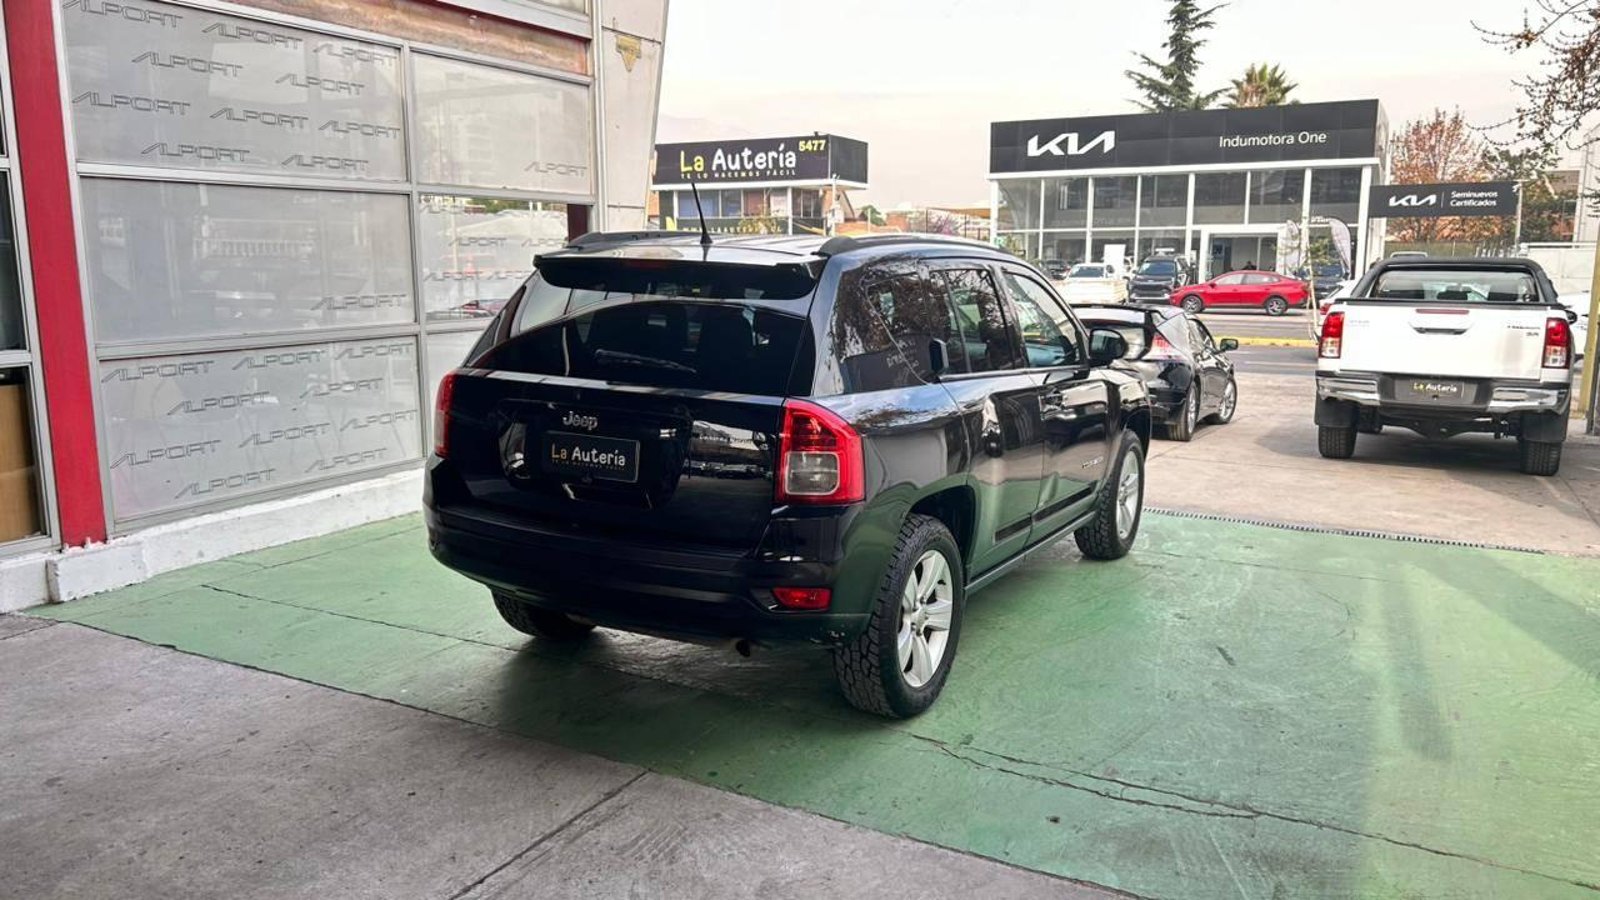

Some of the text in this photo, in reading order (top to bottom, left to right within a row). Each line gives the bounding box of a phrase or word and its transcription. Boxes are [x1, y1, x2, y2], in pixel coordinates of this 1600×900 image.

[202, 23, 303, 50] ALPORT
[131, 51, 243, 77] ALPORT
[313, 43, 397, 67] ALPORT
[275, 73, 365, 95] ALPORT
[72, 91, 190, 115] ALPORT
[209, 107, 309, 129] ALPORT
[318, 119, 400, 139] ALPORT
[798, 139, 826, 152] 5477
[1027, 130, 1116, 157] KIA
[1219, 131, 1327, 149] Indumotora One
[141, 142, 250, 162] ALPORT
[281, 154, 369, 171] ALPORT
[680, 143, 797, 172] La Autería
[1389, 194, 1437, 207] KIA
[1450, 190, 1498, 199] Seminuevos
[1450, 199, 1497, 207] Certificados
[101, 360, 214, 383] ALPORT
[232, 350, 325, 370] ALPORT
[167, 391, 270, 416] ALPORT
[562, 411, 598, 431] Jeep
[239, 422, 330, 448] ALPORT
[110, 440, 221, 469] ALPORT
[304, 447, 387, 473] ALPORT
[551, 443, 567, 460] La
[571, 446, 626, 467] Autería
[175, 468, 276, 499] ALPORT
